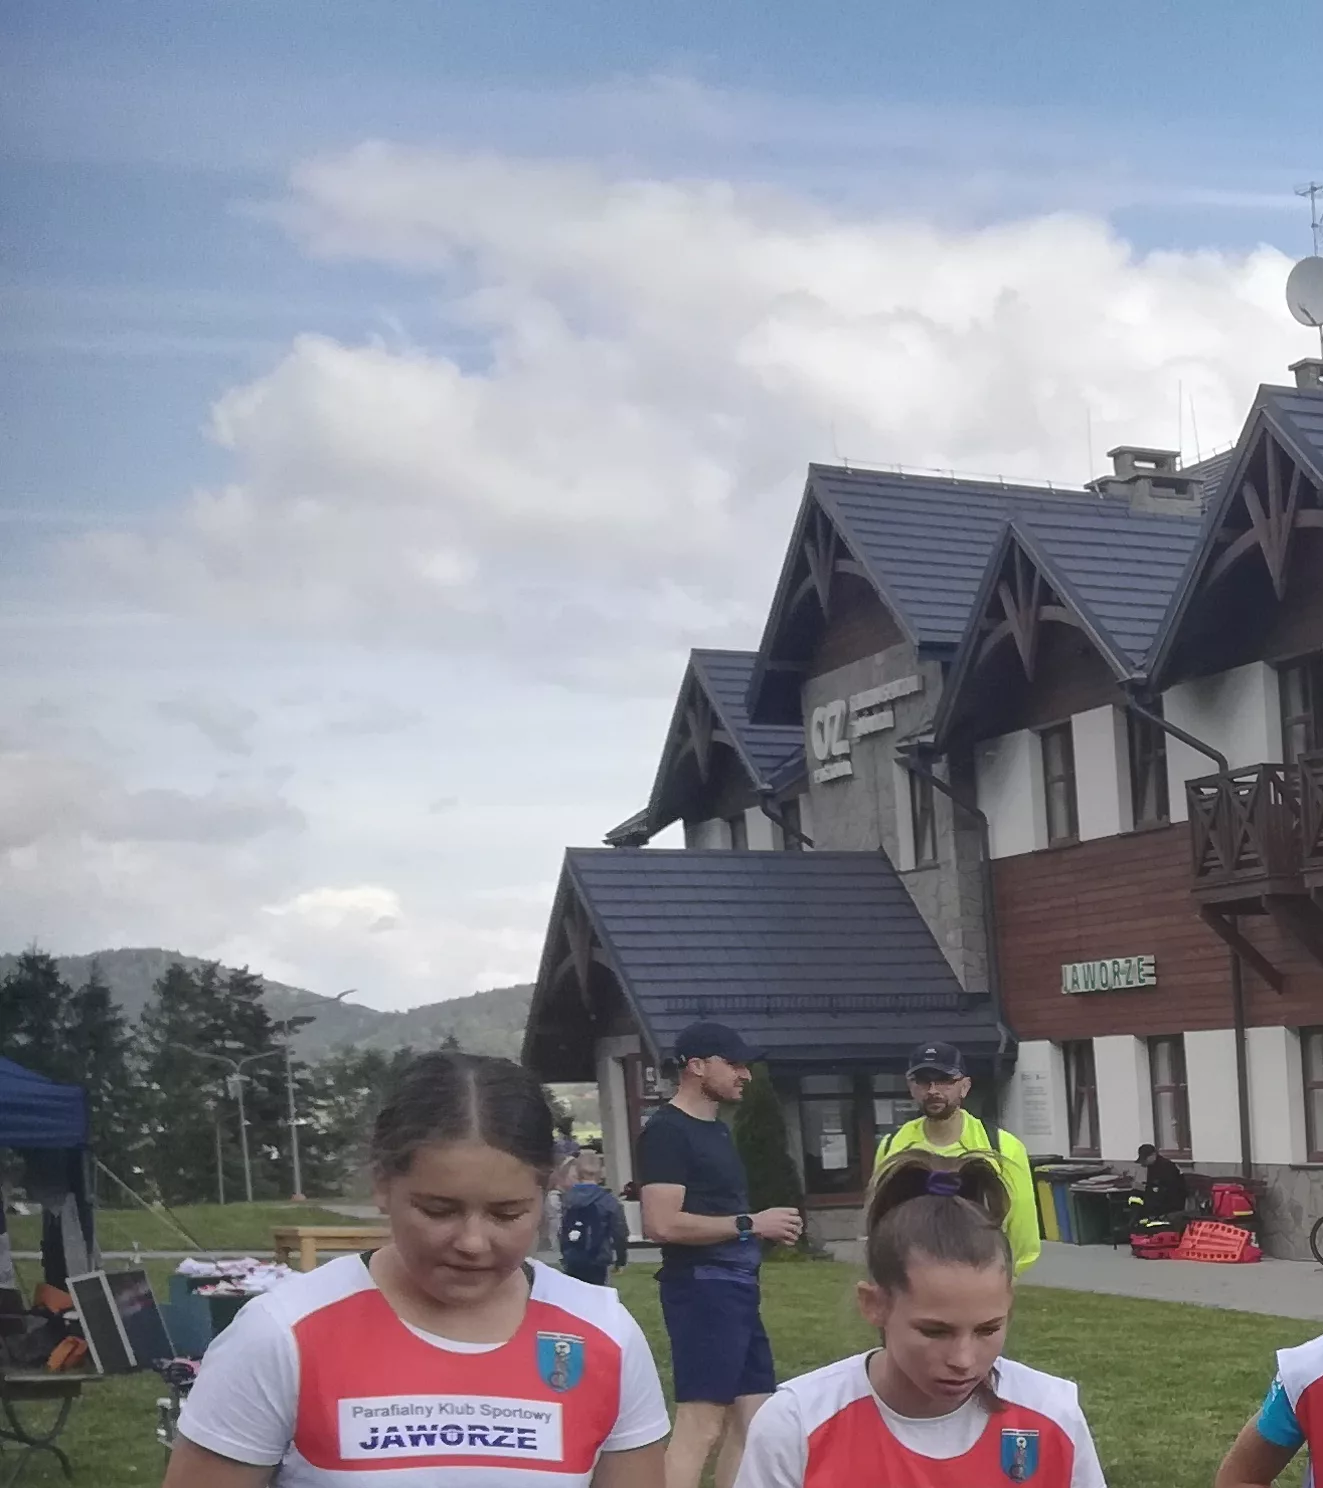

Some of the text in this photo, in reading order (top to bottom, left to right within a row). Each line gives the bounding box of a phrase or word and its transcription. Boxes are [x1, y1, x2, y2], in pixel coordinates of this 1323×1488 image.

[1062, 956, 1150, 993] JAWORZE
[352, 1403, 553, 1424] Parafialny Klub Sportowy
[359, 1424, 538, 1451] JAWORZE
